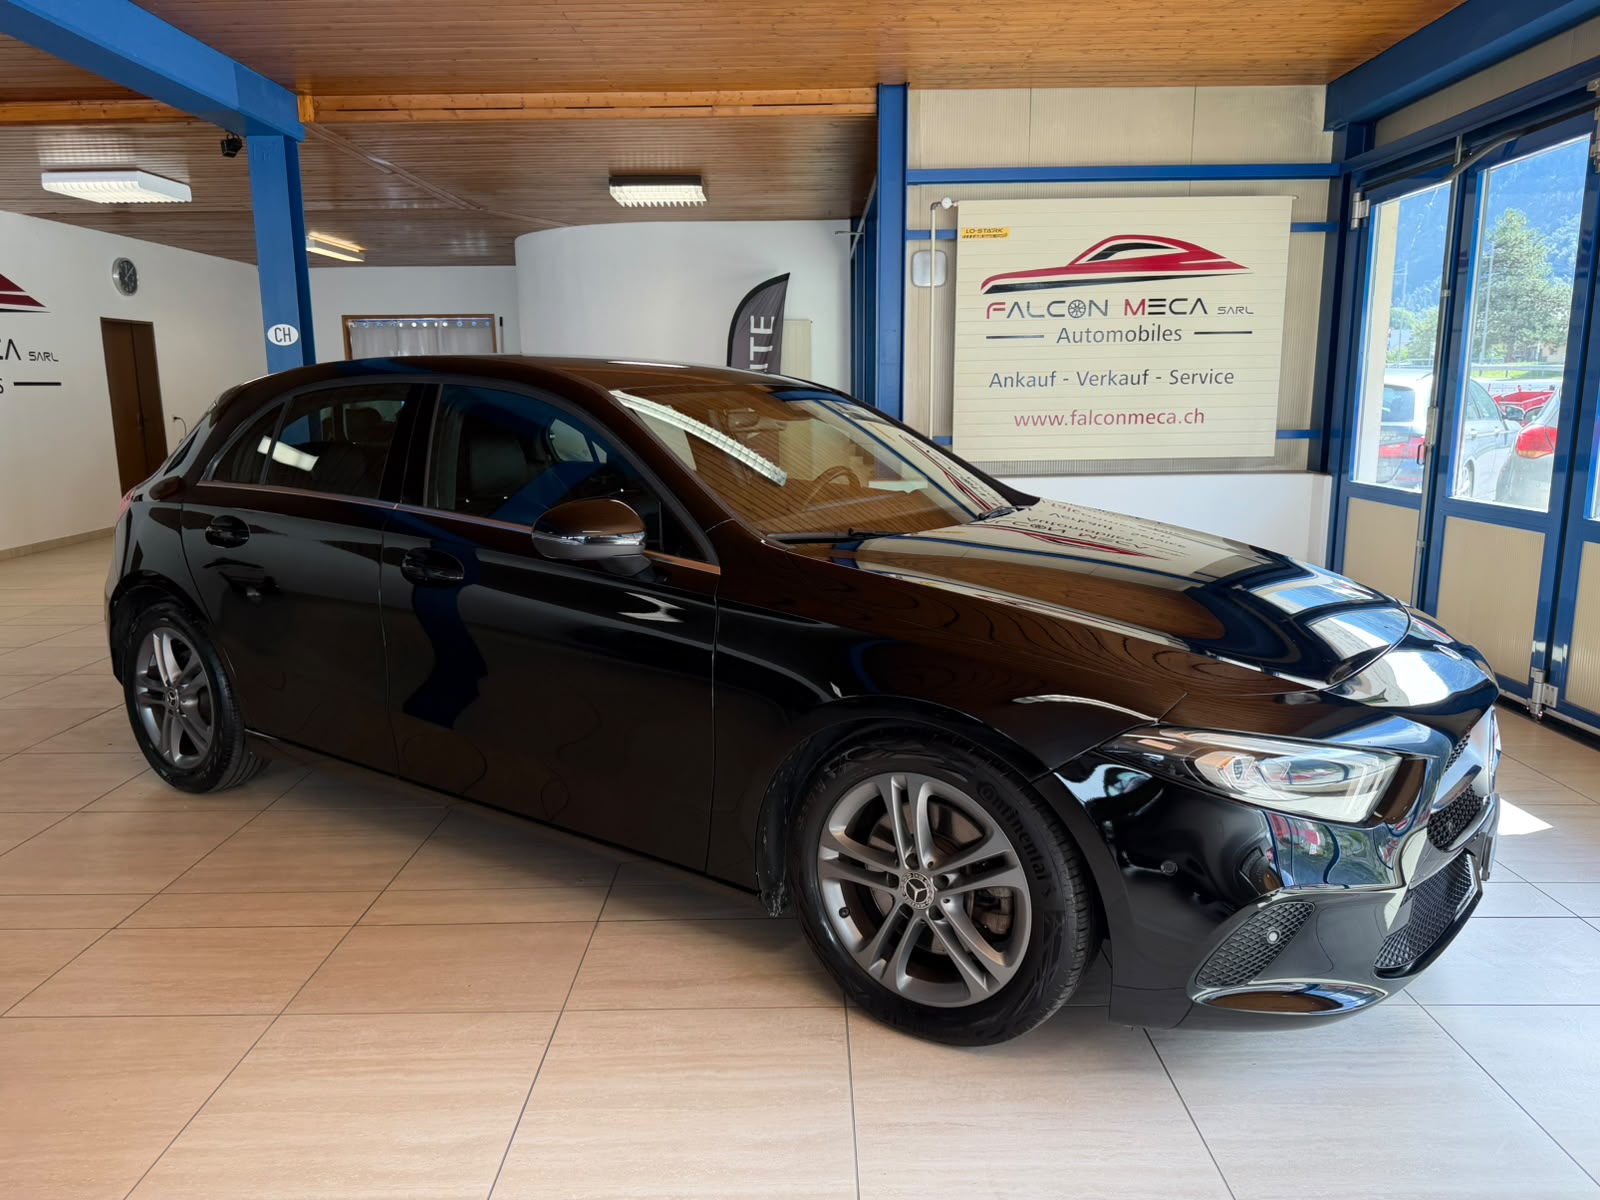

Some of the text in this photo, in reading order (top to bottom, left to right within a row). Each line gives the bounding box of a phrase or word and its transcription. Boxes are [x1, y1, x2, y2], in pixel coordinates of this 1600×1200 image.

[986, 298, 1254, 319] FALCON MECA SARL
[274, 327, 292, 342] CH
[749, 315, 775, 372] ITE
[1056, 323, 1183, 344] Automobiles
[0, 339, 59, 362] A SARL
[989, 370, 1057, 389] Ankauf
[1076, 369, 1150, 387] Verkauf
[1168, 367, 1235, 386] Service
[1013, 408, 1206, 428] www.falconmeca.ch
[976, 781, 1052, 881] Continental
